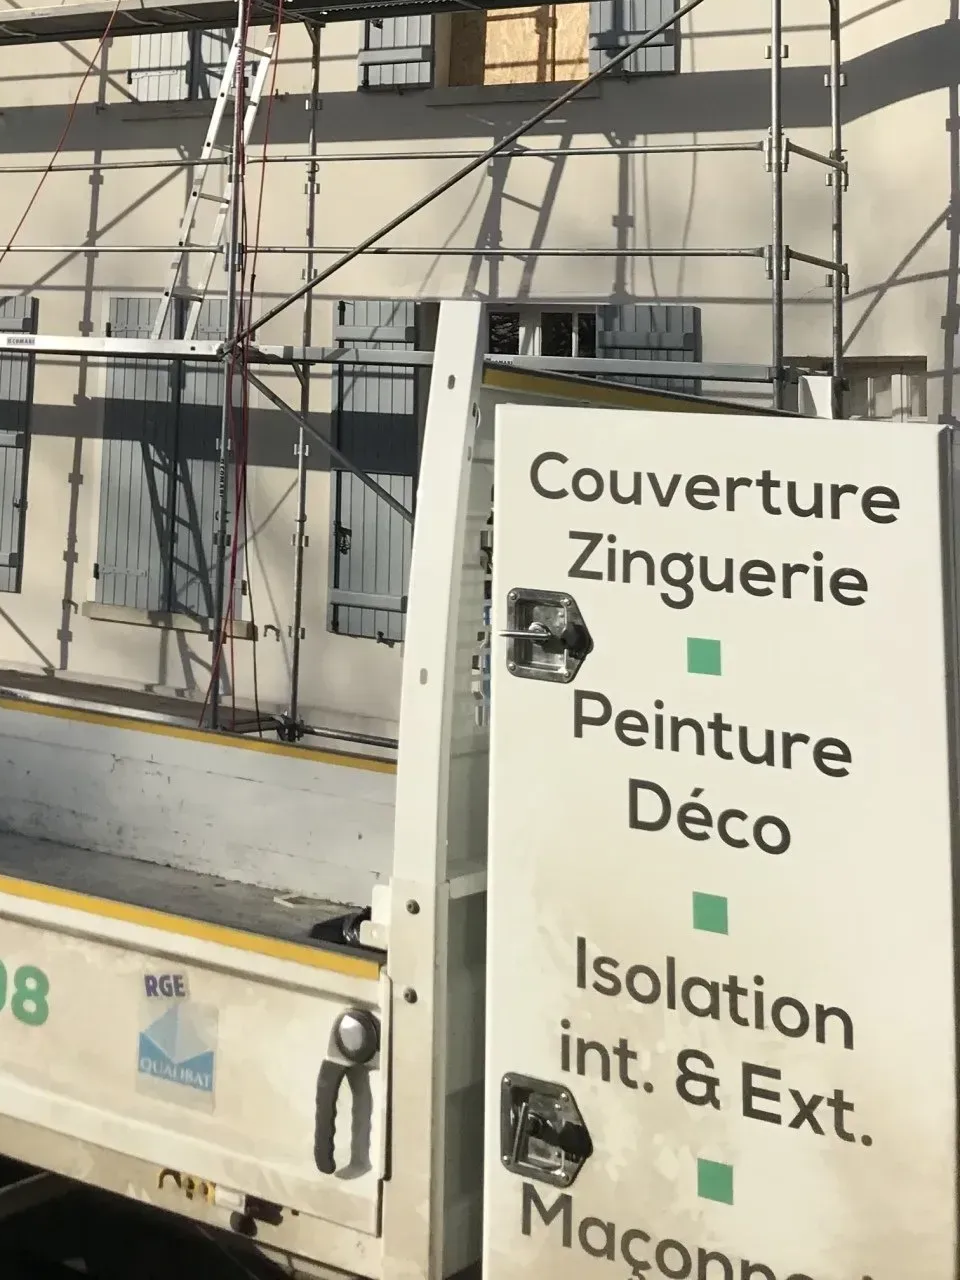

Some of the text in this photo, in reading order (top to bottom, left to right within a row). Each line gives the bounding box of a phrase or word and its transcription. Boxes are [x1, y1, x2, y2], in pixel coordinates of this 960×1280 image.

[530, 451, 900, 524] Couverture
[568, 530, 868, 609] Zinguerie
[574, 689, 852, 778] Peinture
[629, 778, 791, 855] Déco
[144, 974, 186, 998] RGE
[576, 936, 854, 1050] Isolation
[140, 1057, 211, 1089] QUALIBAT
[560, 1018, 873, 1147] int. & Ext.
[521, 1182, 874, 1280] Maçonn
